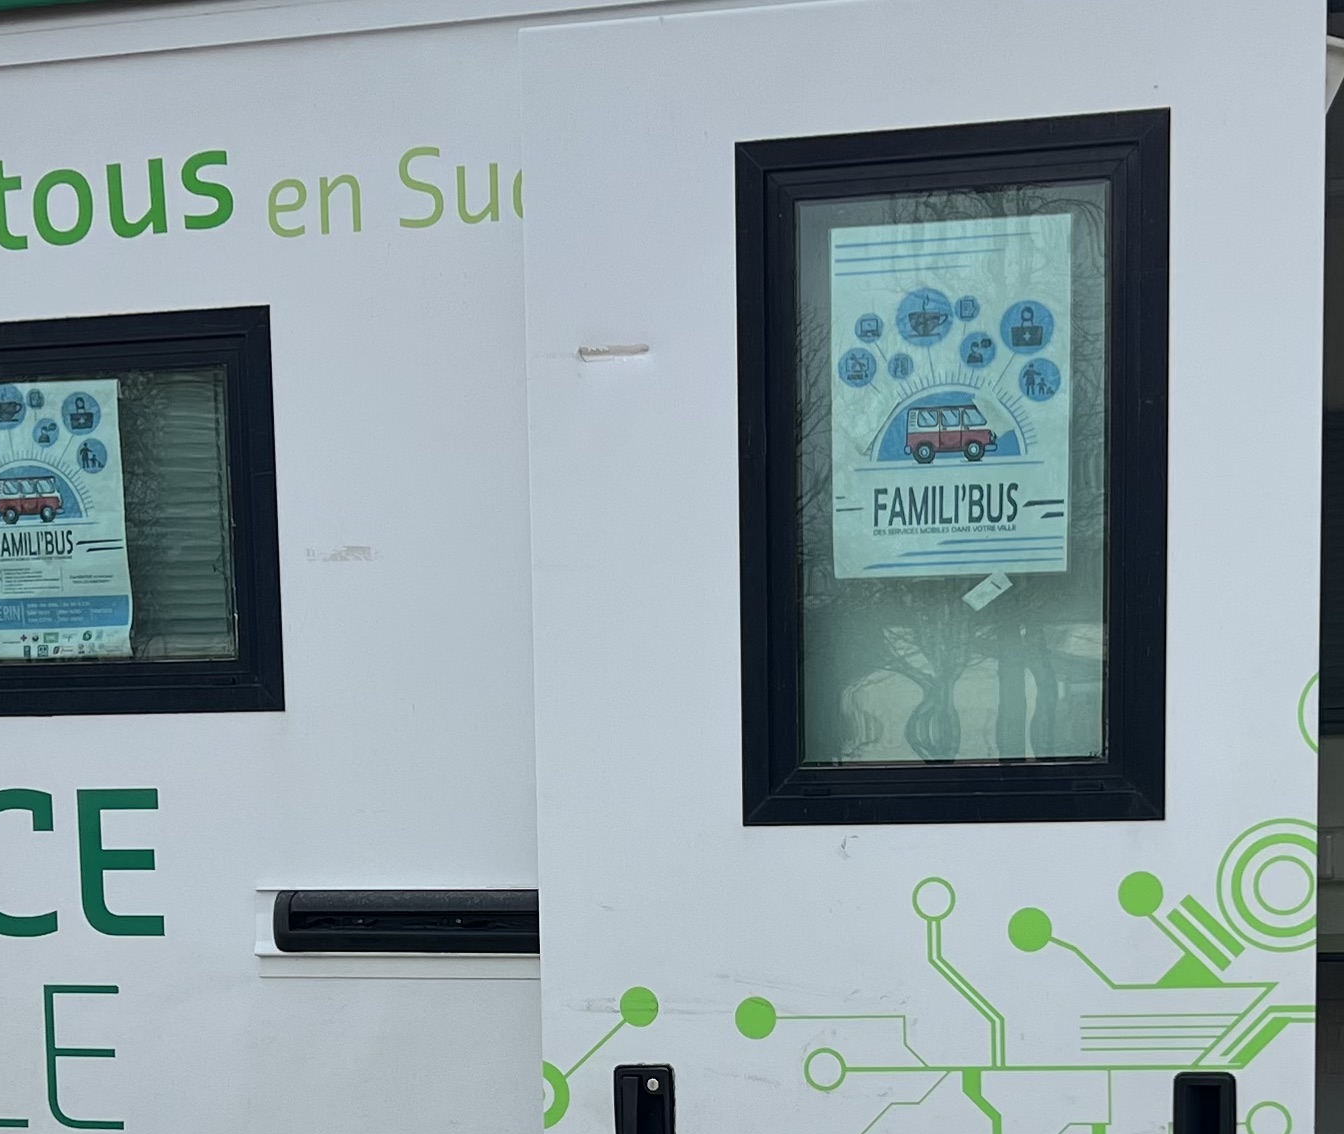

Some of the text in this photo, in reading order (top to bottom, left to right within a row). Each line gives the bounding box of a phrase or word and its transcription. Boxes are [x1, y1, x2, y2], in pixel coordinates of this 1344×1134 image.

[267, 173, 362, 239] en
[398, 145, 524, 230] Su
[873, 482, 1019, 528] FAMILI'BUS
